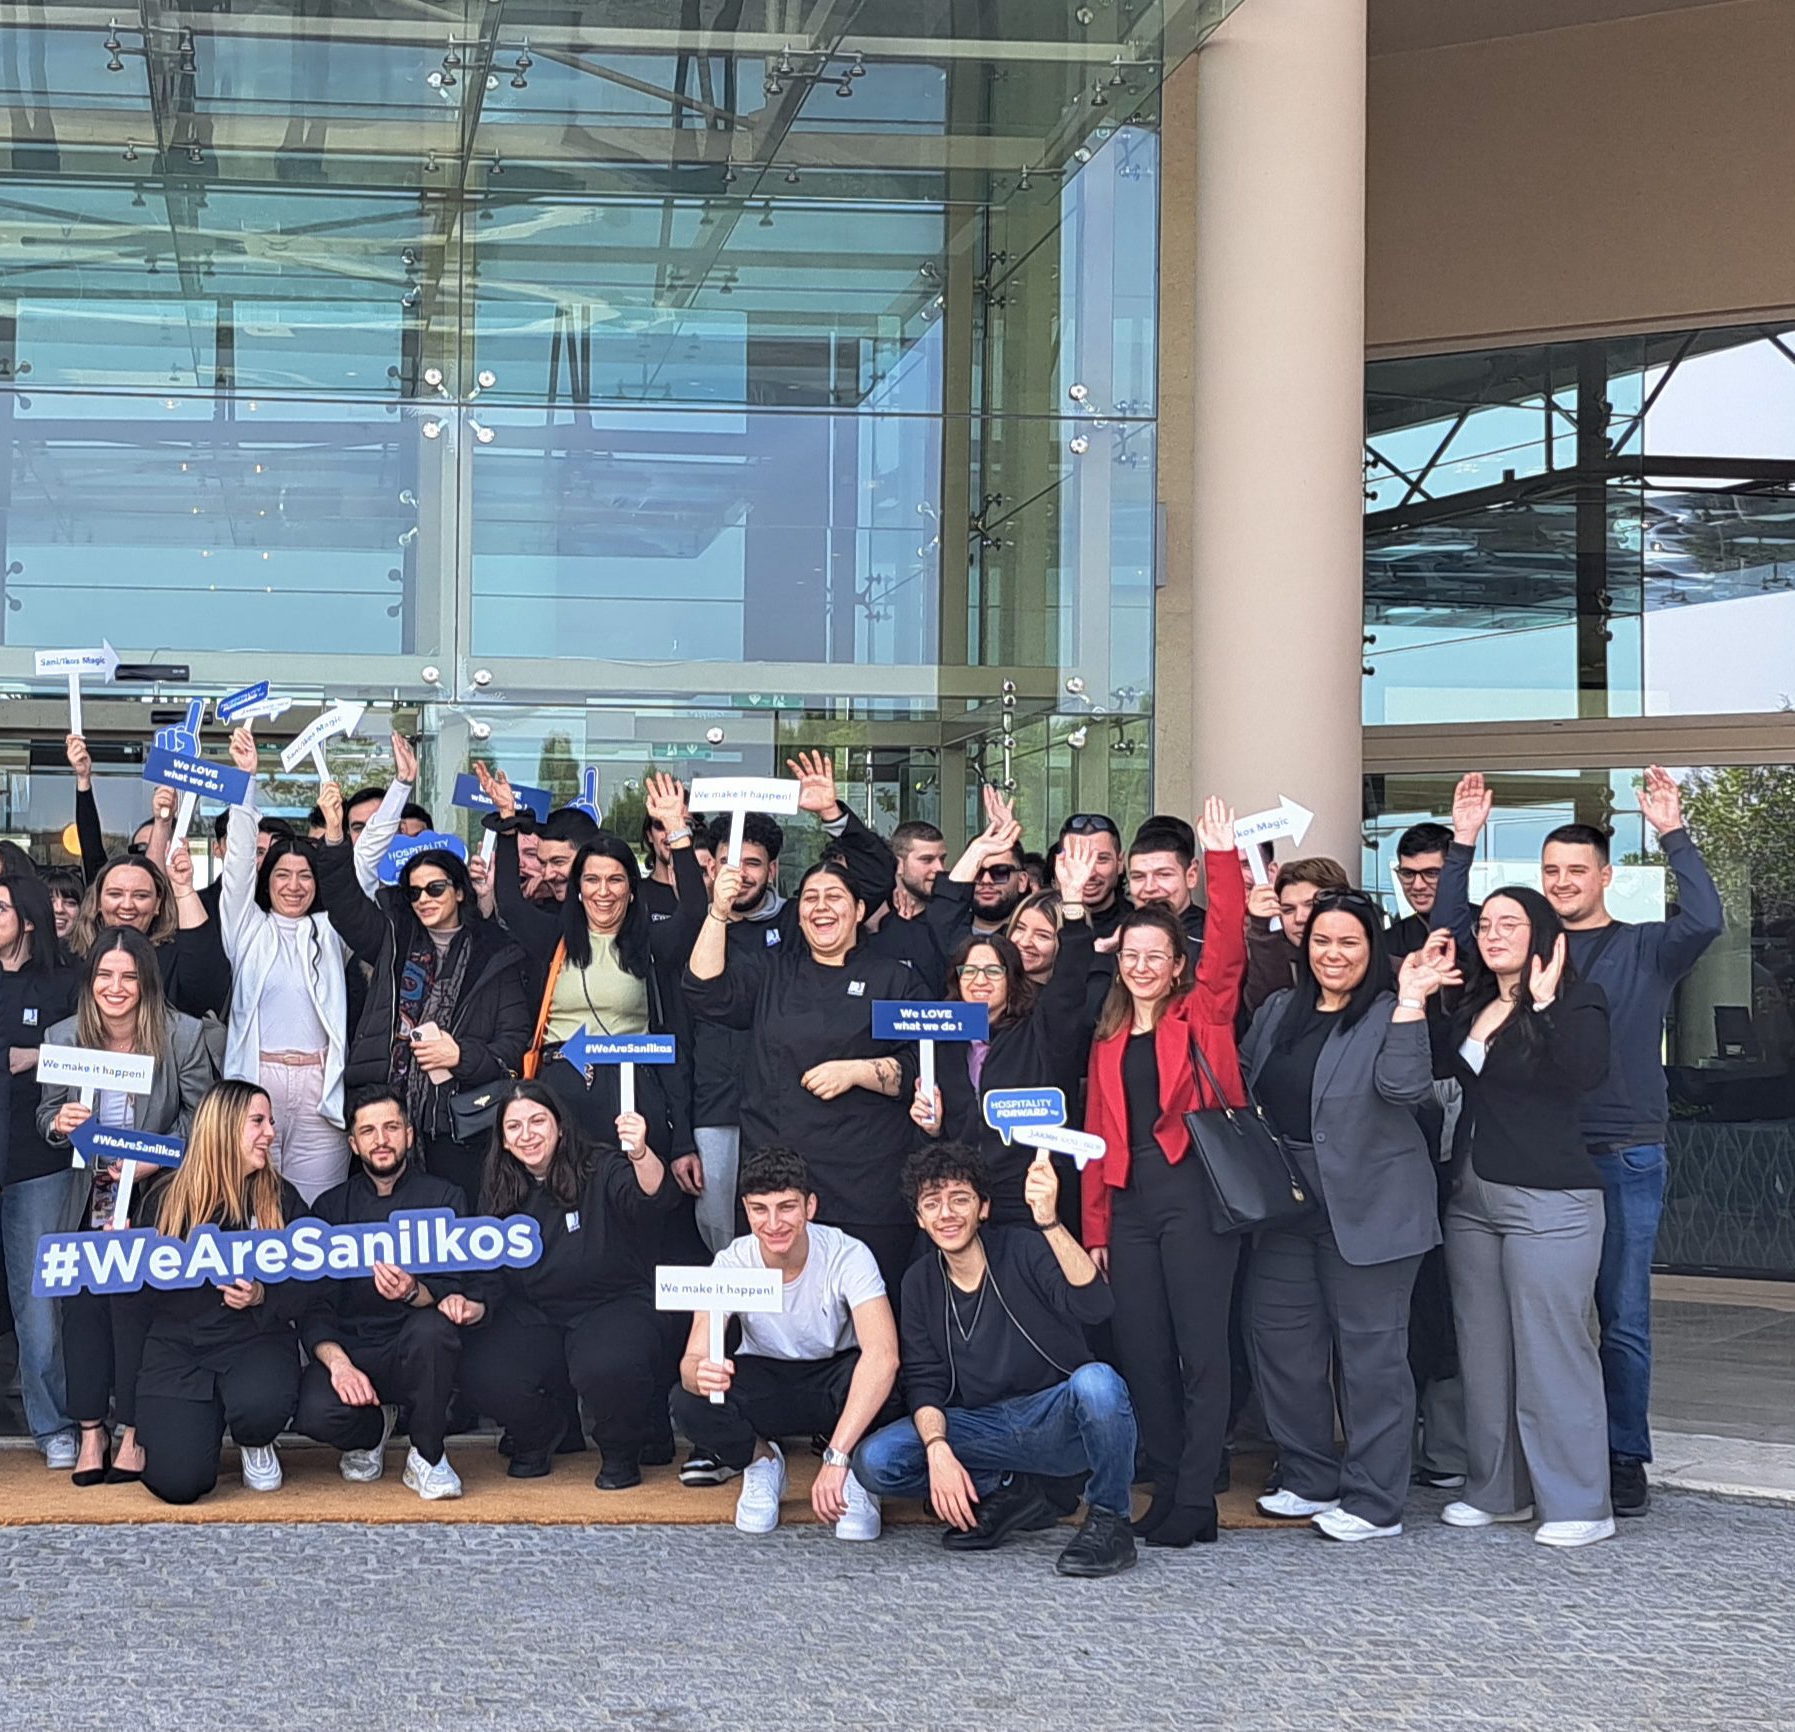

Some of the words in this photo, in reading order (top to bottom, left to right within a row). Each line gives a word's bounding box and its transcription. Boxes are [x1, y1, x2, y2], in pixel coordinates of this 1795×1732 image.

[82, 656, 106, 666] Magic
[173, 759, 189, 771] We
[191, 763, 219, 779] LOVE
[163, 769, 188, 783] what
[189, 776, 203, 787] we
[205, 779, 218, 791] do
[694, 791, 709, 799] We
[712, 790, 738, 799] make
[740, 790, 747, 799] it
[749, 790, 792, 801] happen!
[1256, 817, 1290, 831] Magic
[387, 838, 449, 861] HOSPITALITY
[900, 1008, 919, 1018] We
[921, 1009, 953, 1019] LOVE
[893, 1021, 921, 1031] what
[922, 1022, 939, 1031] we
[940, 1021, 956, 1031] do
[42, 1058, 59, 1069] We
[61, 1062, 90, 1073] make
[92, 1064, 100, 1074] it
[102, 1064, 145, 1079] happen!
[990, 1099, 1052, 1109] HOSPITALITY
[996, 1108, 1048, 1118] FORWARD
[660, 1283, 679, 1293] We
[682, 1283, 713, 1294] make
[715, 1283, 723, 1294] it
[726, 1283, 774, 1297] happen!
